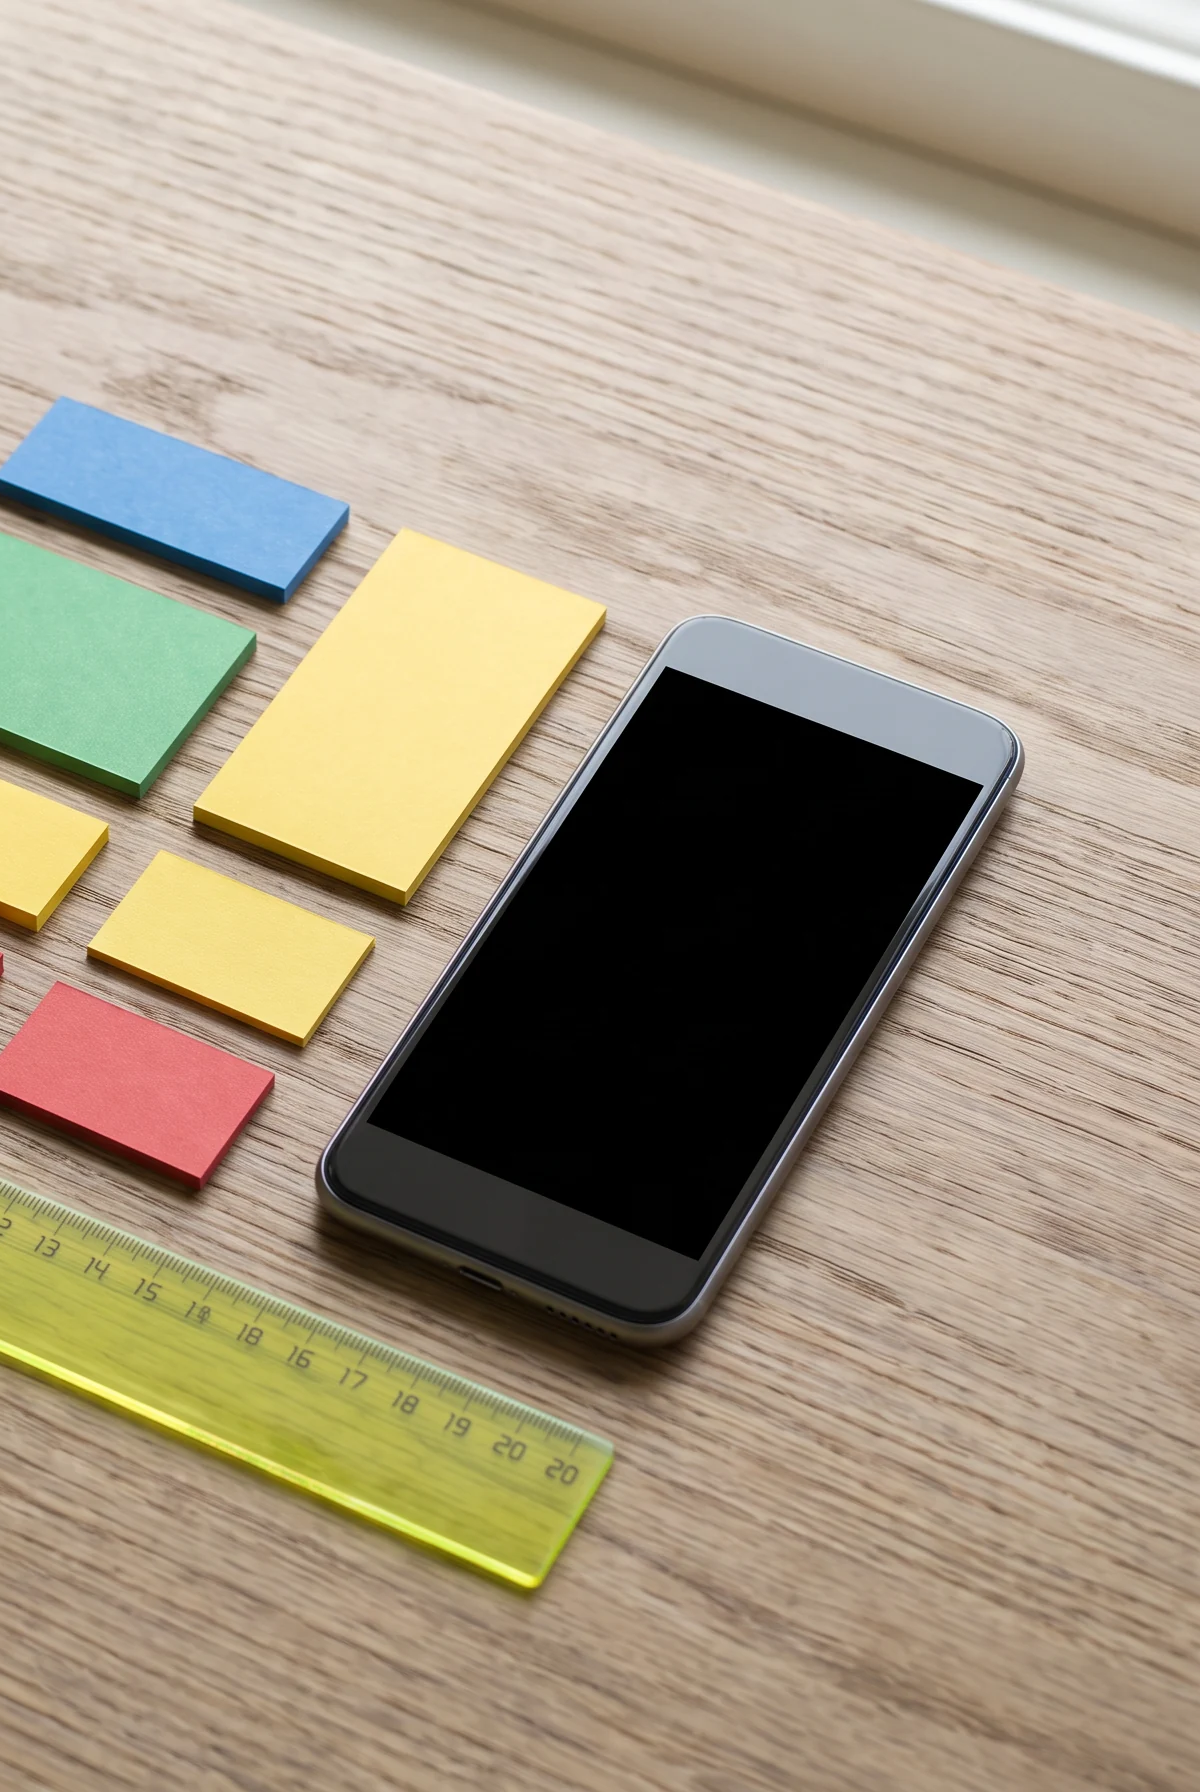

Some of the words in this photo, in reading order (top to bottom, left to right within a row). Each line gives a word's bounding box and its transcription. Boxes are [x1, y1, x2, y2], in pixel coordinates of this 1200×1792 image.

[34, 1236, 60, 1258] 13
[83, 1257, 110, 1279] 14
[133, 1278, 162, 1301] 15
[236, 1324, 263, 1346] 18
[287, 1346, 314, 1370] 16
[339, 1368, 368, 1390] 17
[391, 1391, 419, 1415] 18
[444, 1413, 472, 1437] 19
[492, 1435, 527, 1462] 20
[545, 1458, 579, 1486] 20
